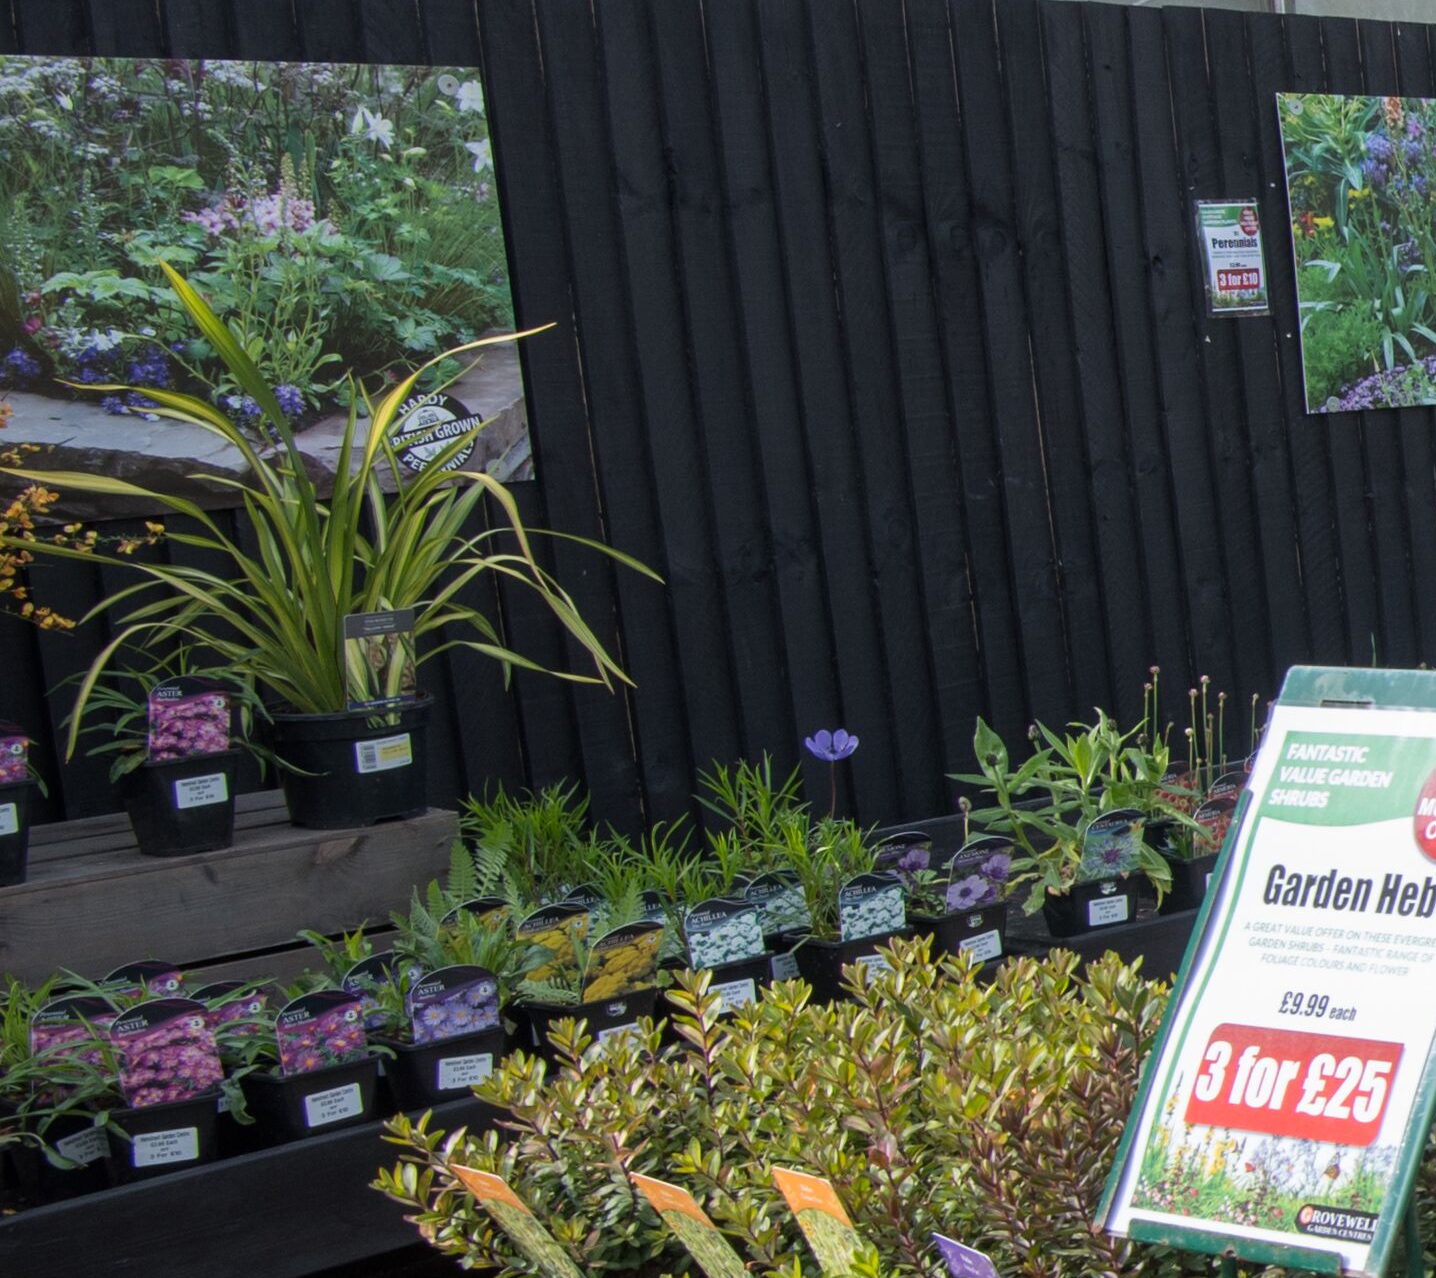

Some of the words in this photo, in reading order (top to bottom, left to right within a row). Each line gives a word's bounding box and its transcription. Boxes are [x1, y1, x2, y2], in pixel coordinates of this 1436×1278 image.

[1212, 238, 1258, 249] Perennials
[1219, 274, 1226, 286] 3
[1228, 273, 1241, 286] for
[1242, 272, 1258, 285] £10
[435, 416, 480, 440] GROWN
[156, 689, 184, 699] ASTER
[1286, 743, 1370, 763] FANTASTIC
[1279, 766, 1327, 786] VALUE
[1328, 768, 1393, 789] GARDEN
[1268, 788, 1330, 808] SHRUBS
[844, 886, 876, 898] ACHILLEA
[1263, 864, 1374, 912] Garden
[692, 912, 728, 924] ACHILLEA
[1243, 922, 1251, 931] A
[1251, 922, 1284, 934] GREAT
[1284, 924, 1314, 937] VALUE
[1314, 926, 1344, 940] OFFER
[1346, 930, 1361, 942] ON
[1364, 930, 1393, 944] THESE
[1248, 936, 1287, 950] GARDEN
[1288, 939, 1325, 953] SHRUBS
[1332, 944, 1385, 958] FANTASTIC
[1386, 948, 1419, 963] RANGE
[1420, 952, 1435, 964] OF
[1260, 953, 1300, 968] FOLIAGE
[1300, 956, 1345, 972] COLOURS
[1345, 960, 1368, 973] AND
[1368, 963, 1409, 978] FLOWER
[417, 984, 446, 996] ASTER
[1278, 990, 1330, 1018] £9.99
[1328, 1006, 1357, 1022] each
[117, 1020, 148, 1033] ASTER
[282, 1011, 310, 1024] ASTER
[1194, 1040, 1233, 1102] 3
[1228, 1046, 1301, 1110] for
[1295, 1053, 1393, 1124] £25
[1307, 1224, 1338, 1237] GARDEN
[1338, 1227, 1373, 1242] CENTRES
